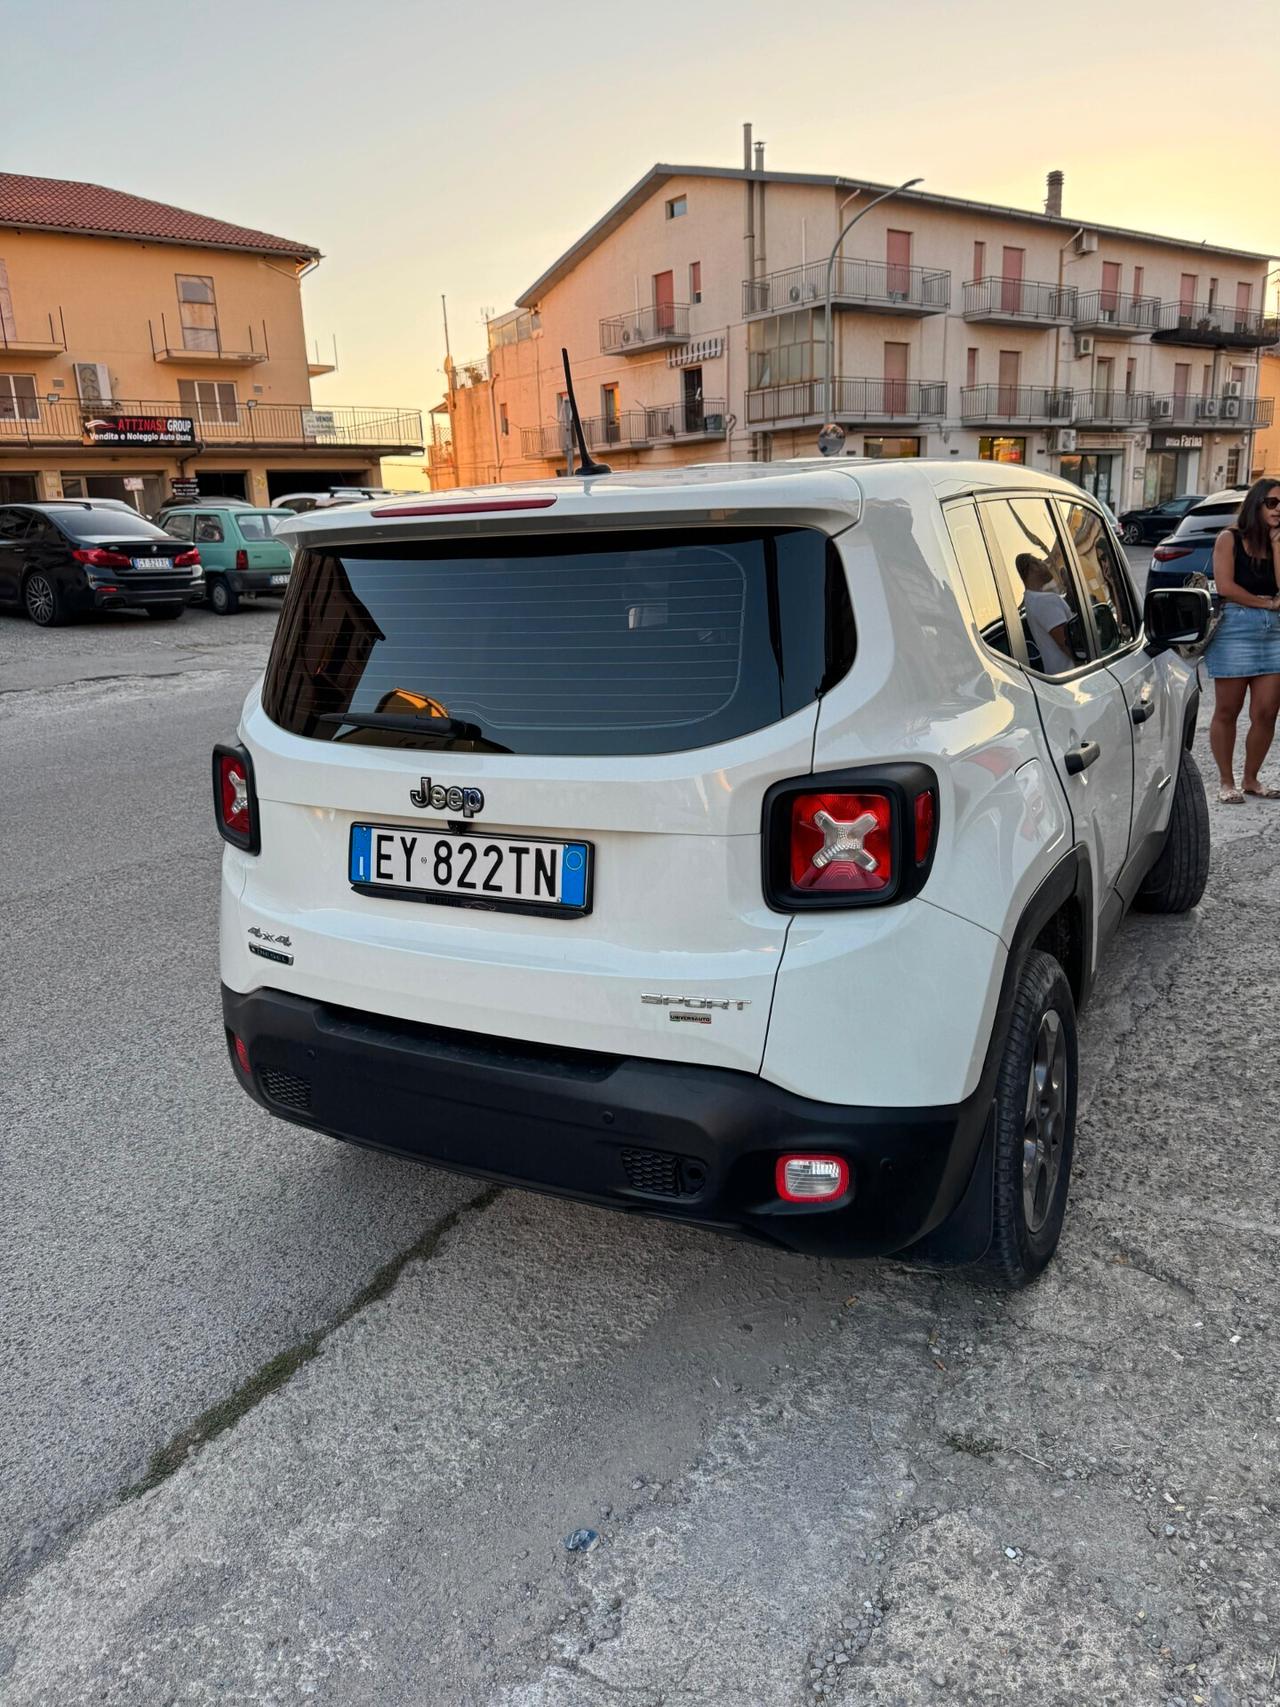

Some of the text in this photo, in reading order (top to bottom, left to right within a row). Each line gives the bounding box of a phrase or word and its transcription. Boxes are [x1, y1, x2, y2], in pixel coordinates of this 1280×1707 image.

[167, 420, 191, 432] GROUP
[89, 432, 118, 440] Vendita
[127, 432, 158, 441] Noleggio
[1181, 434, 1202, 447] Farina
[410, 777, 484, 818] Jeep
[376, 834, 557, 897] EY 822TN
[641, 993, 752, 1010] SPORT
[670, 1014, 710, 1022] UNIVERSAUTO
